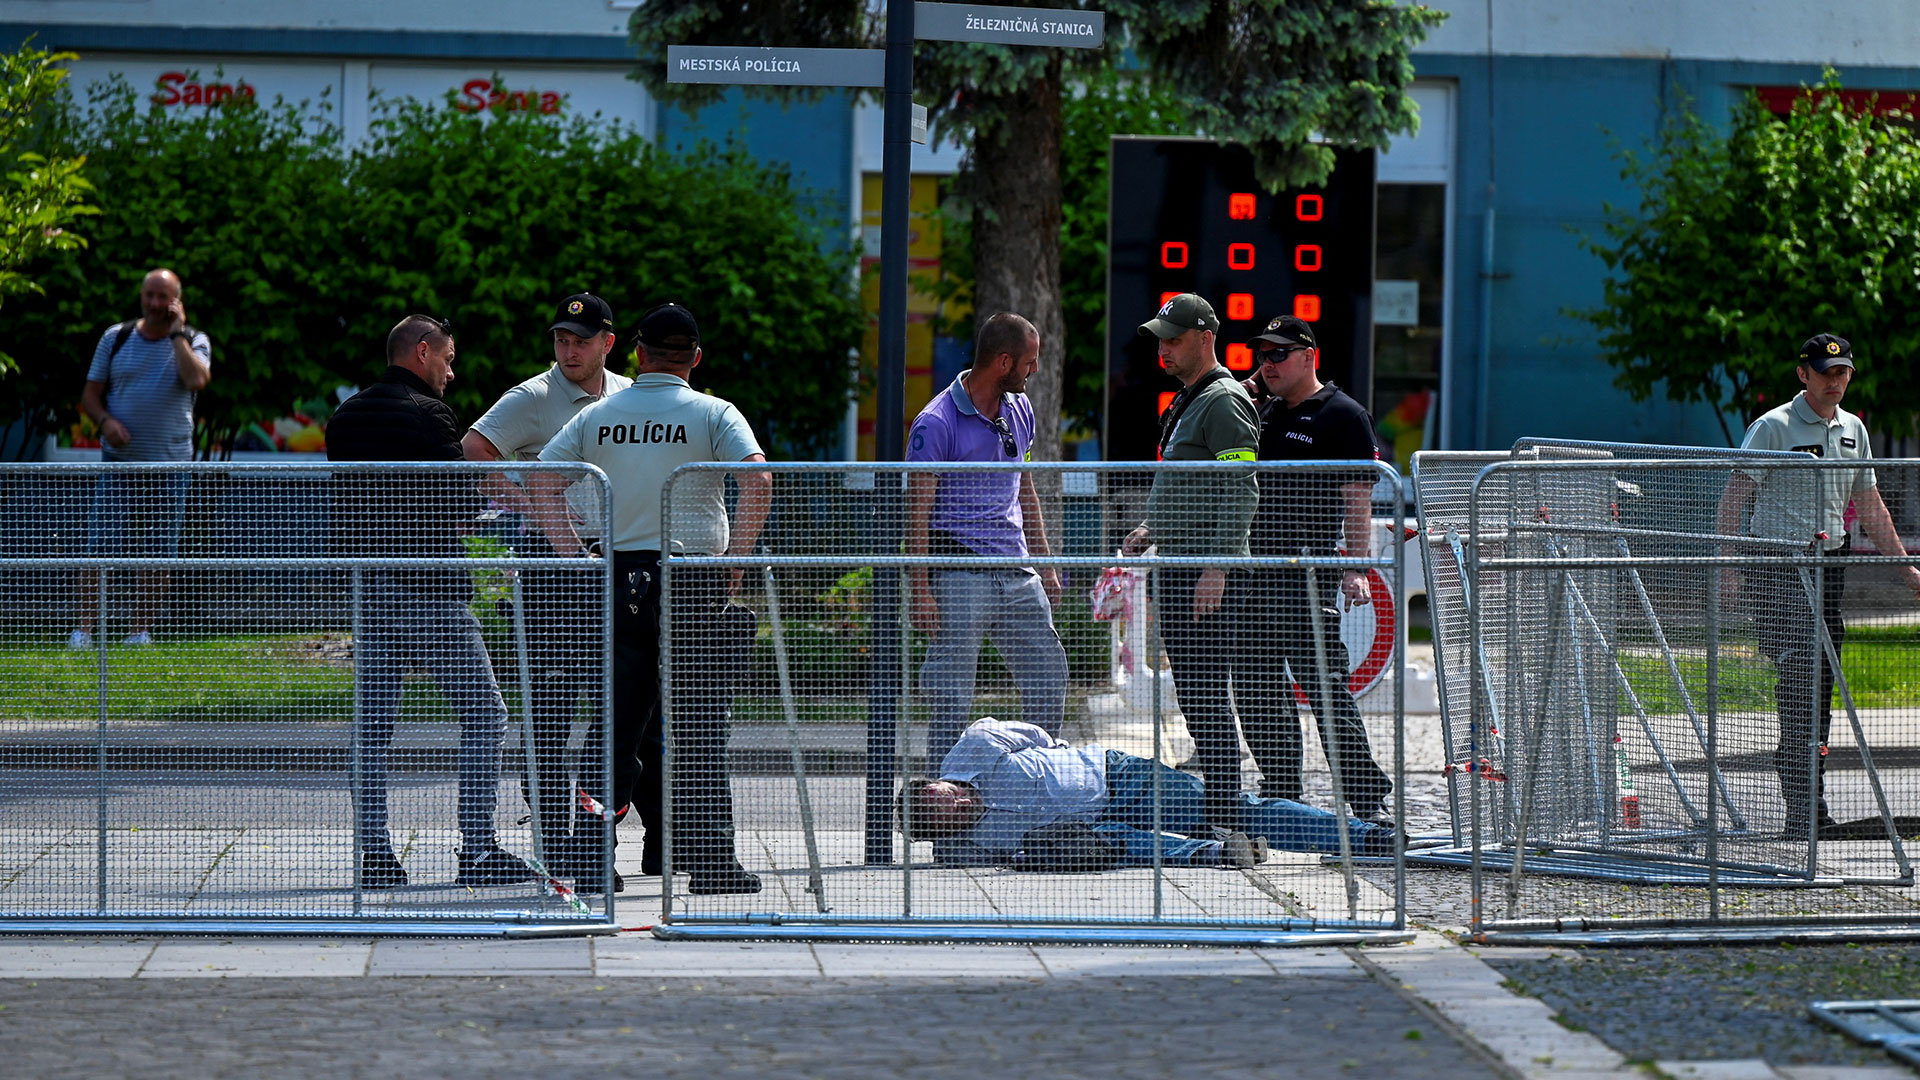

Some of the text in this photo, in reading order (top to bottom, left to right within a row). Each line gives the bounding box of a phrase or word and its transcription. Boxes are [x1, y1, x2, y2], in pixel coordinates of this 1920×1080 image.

[966, 14, 1094, 36] ŽELEZNIČNÁ STANICA
[680, 56, 801, 72] MESTSKÁ POLÍCIA
[598, 420, 688, 445] POLÍCIA
[912, 425, 927, 451] 6
[1285, 431, 1313, 444] POLÍCIA
